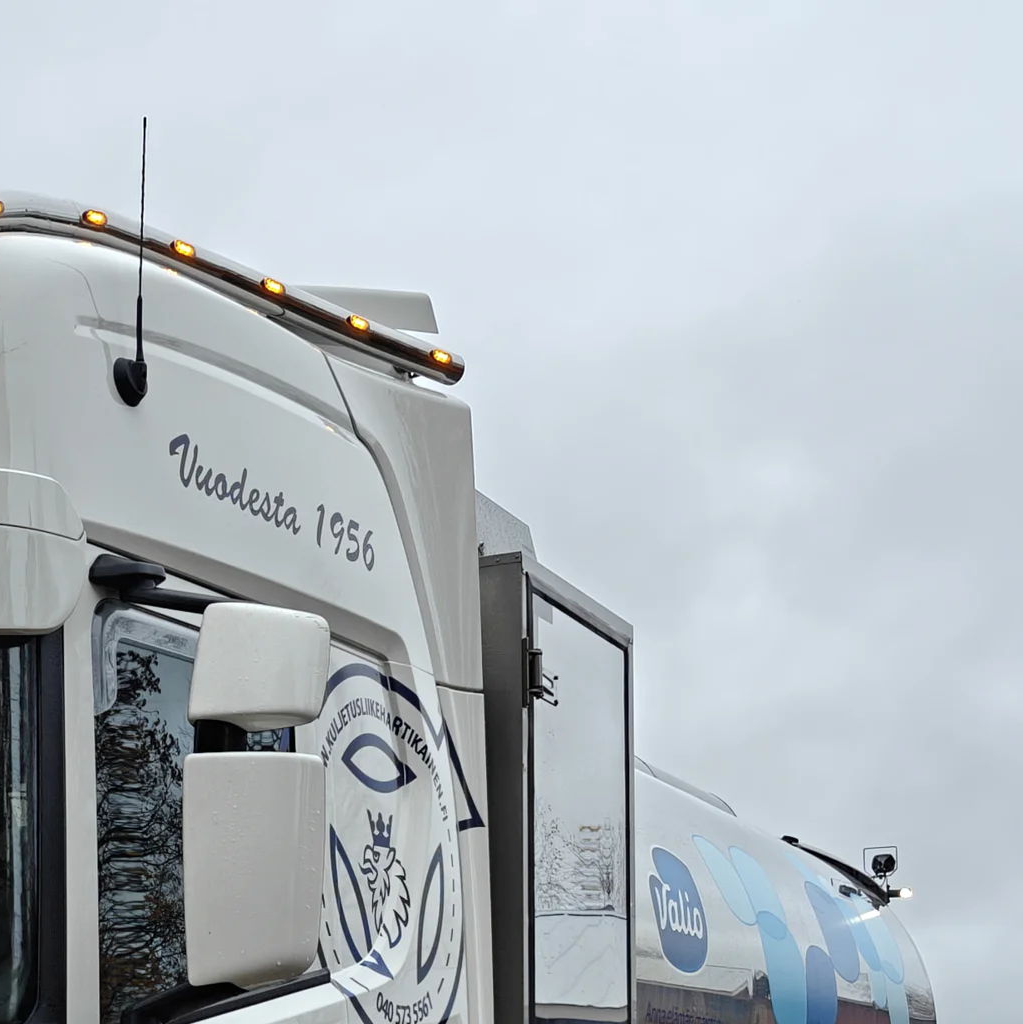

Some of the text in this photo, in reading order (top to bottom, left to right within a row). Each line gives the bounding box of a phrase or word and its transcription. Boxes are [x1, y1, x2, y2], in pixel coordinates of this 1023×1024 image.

[169, 433, 375, 571] Vuodesta 1956
[654, 884, 704, 940] Valio
[376, 991, 394, 1022] 040
[412, 991, 433, 1024] 5561
